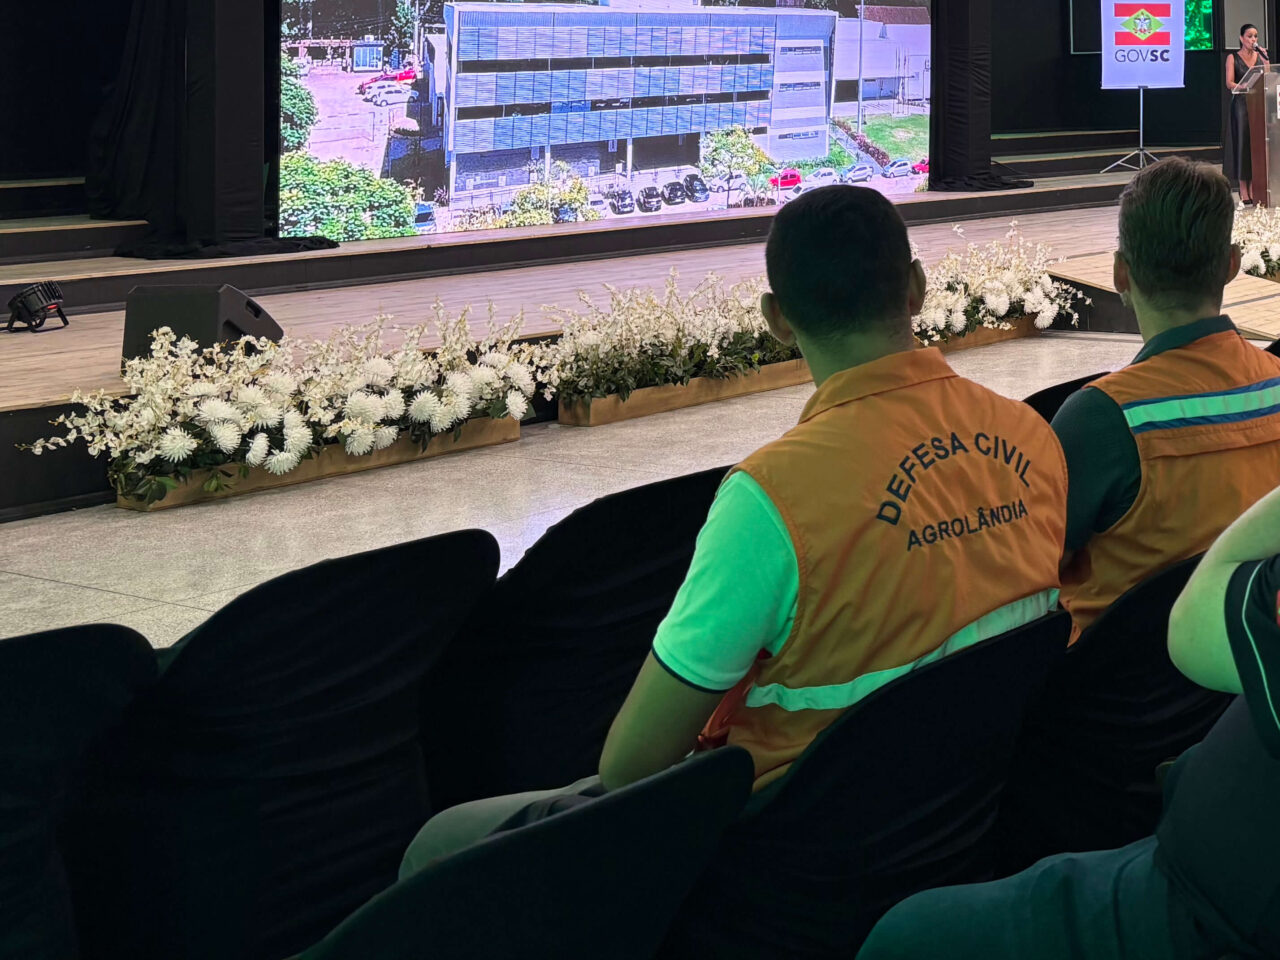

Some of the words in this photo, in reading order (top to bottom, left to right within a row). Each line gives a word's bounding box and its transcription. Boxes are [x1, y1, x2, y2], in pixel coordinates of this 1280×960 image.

[1115, 49, 1170, 63] GOVSC
[876, 432, 969, 526] DEFESA
[974, 432, 1031, 488] CIVIL
[907, 499, 1028, 552] AGROLÂNDIA
